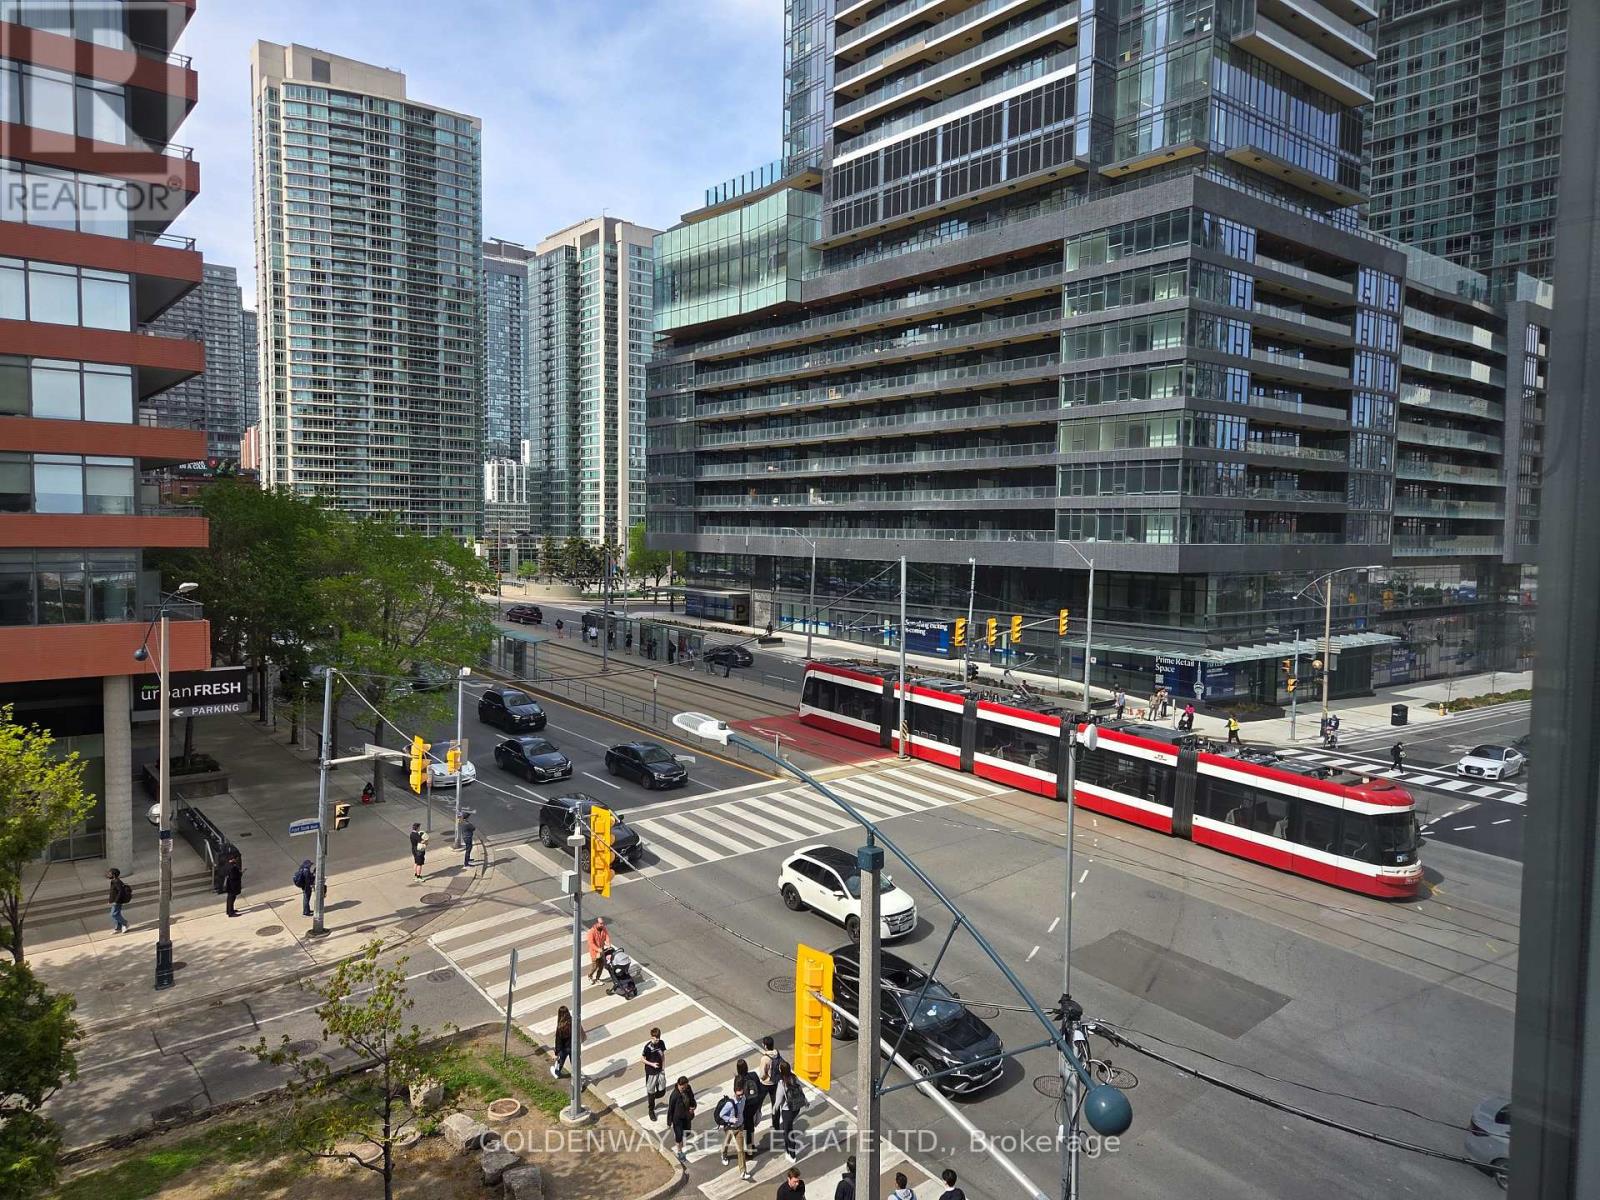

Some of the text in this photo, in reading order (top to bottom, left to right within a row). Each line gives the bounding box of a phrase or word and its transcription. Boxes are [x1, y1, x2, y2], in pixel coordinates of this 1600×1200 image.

[736, 604, 746, 618] P
[1155, 655, 1175, 665] Prime
[1175, 658, 1195, 667] Retail
[1155, 663, 1175, 673] Space
[141, 682, 241, 700] uranFRESH
[192, 704, 239, 715] PARKING
